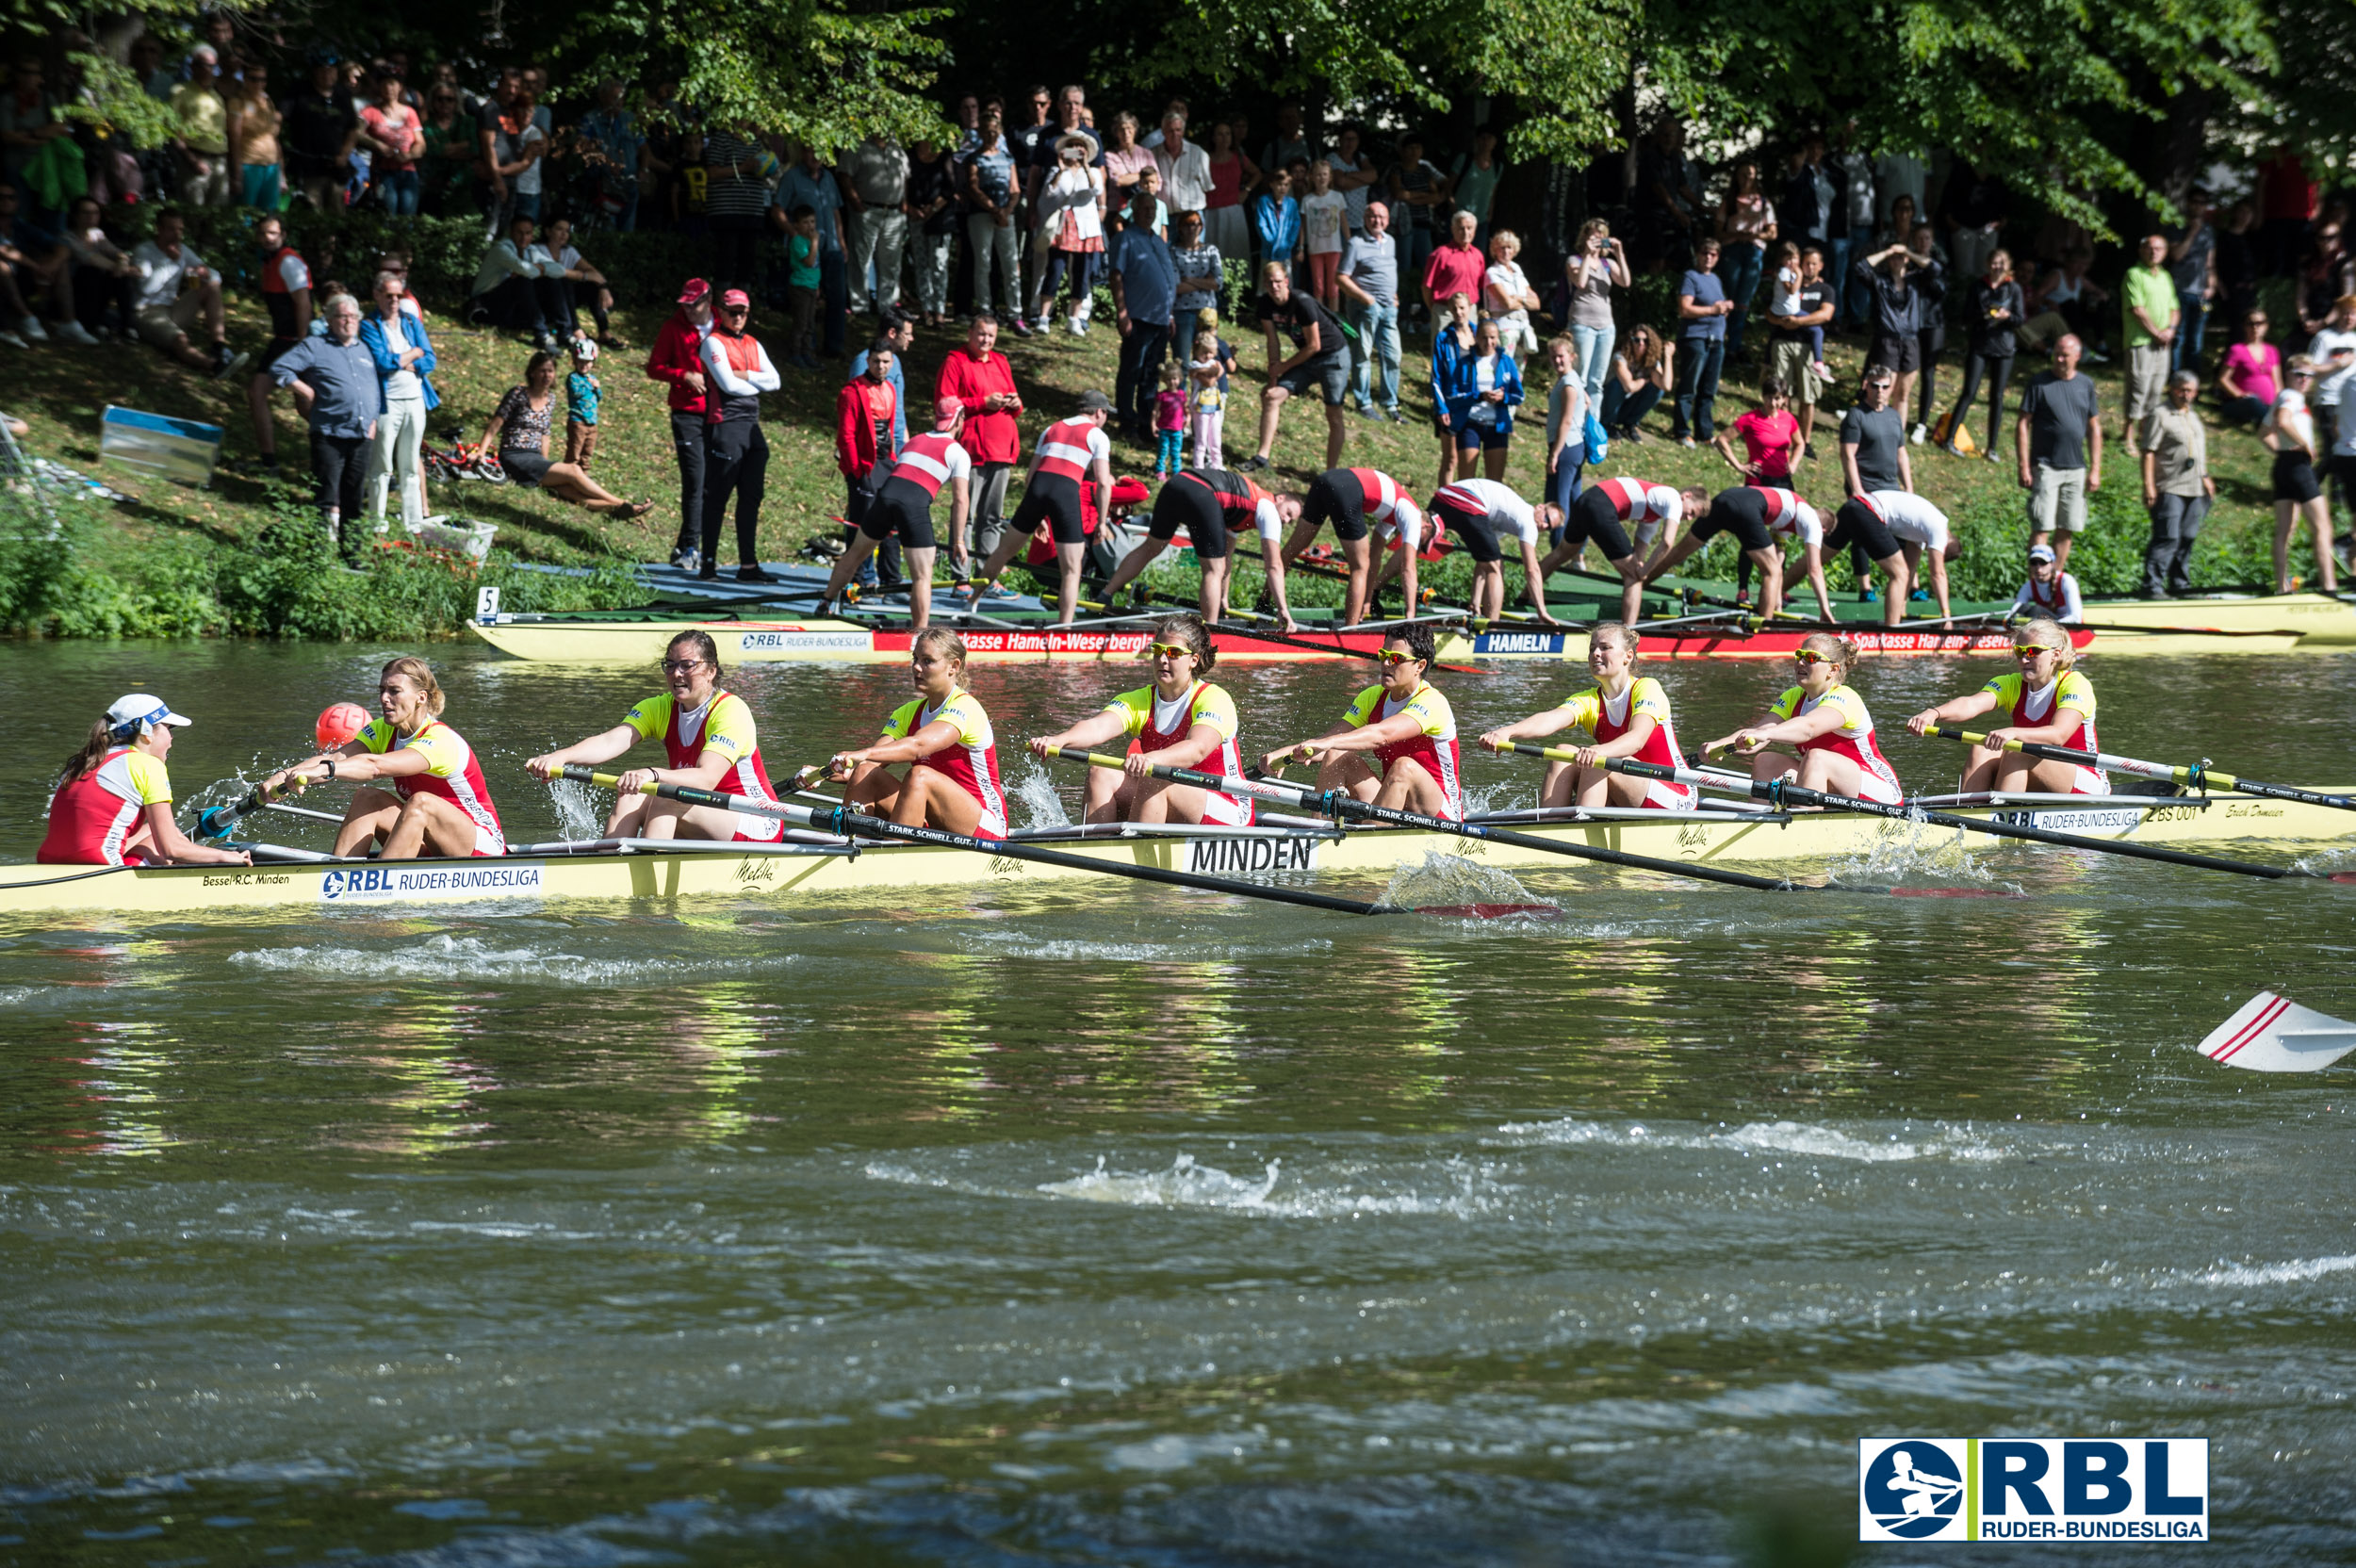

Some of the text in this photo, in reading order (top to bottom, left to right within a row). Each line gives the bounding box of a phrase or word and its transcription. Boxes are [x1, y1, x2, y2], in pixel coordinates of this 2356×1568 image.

[483, 589, 493, 612] 5
[757, 635, 867, 647] RBL RUDER-BUNDESLIGA
[1006, 632, 1153, 653] Hameln-Weserbergla
[1488, 633, 1551, 652] HAMELN
[1853, 632, 1915, 650] Sparkasse
[719, 735, 735, 750] RBL
[2115, 760, 2153, 777] Melitta
[1242, 782, 1281, 797] Melitta
[1694, 773, 1733, 790] Melitta
[2239, 783, 2265, 793] STARK.
[2266, 787, 2300, 800] SCHNELL.
[750, 799, 790, 816] Melitta
[1824, 795, 1850, 808] STARK.
[1851, 800, 1886, 814] SCHNELL.
[2157, 807, 2173, 822] BS
[2176, 806, 2197, 821] 001
[2225, 804, 2284, 818] Erich Domeier
[1377, 808, 1482, 835] STARK. SCHNELL. GUT. RBL
[2008, 810, 2138, 829] RBL RUDER-BUNDESLIGA
[888, 825, 915, 837] STARK.
[916, 829, 953, 843] SCHNELL.
[982, 841, 996, 849] RBL
[1672, 821, 1710, 848] Melitta
[1190, 838, 1313, 873] MINDEN
[1452, 836, 1487, 857] Melitta
[732, 853, 775, 883] Melitta
[985, 854, 1025, 874] Melitta
[255, 874, 290, 885] Minden
[347, 869, 540, 891] RBL RUDER-BUNDESLIGA
